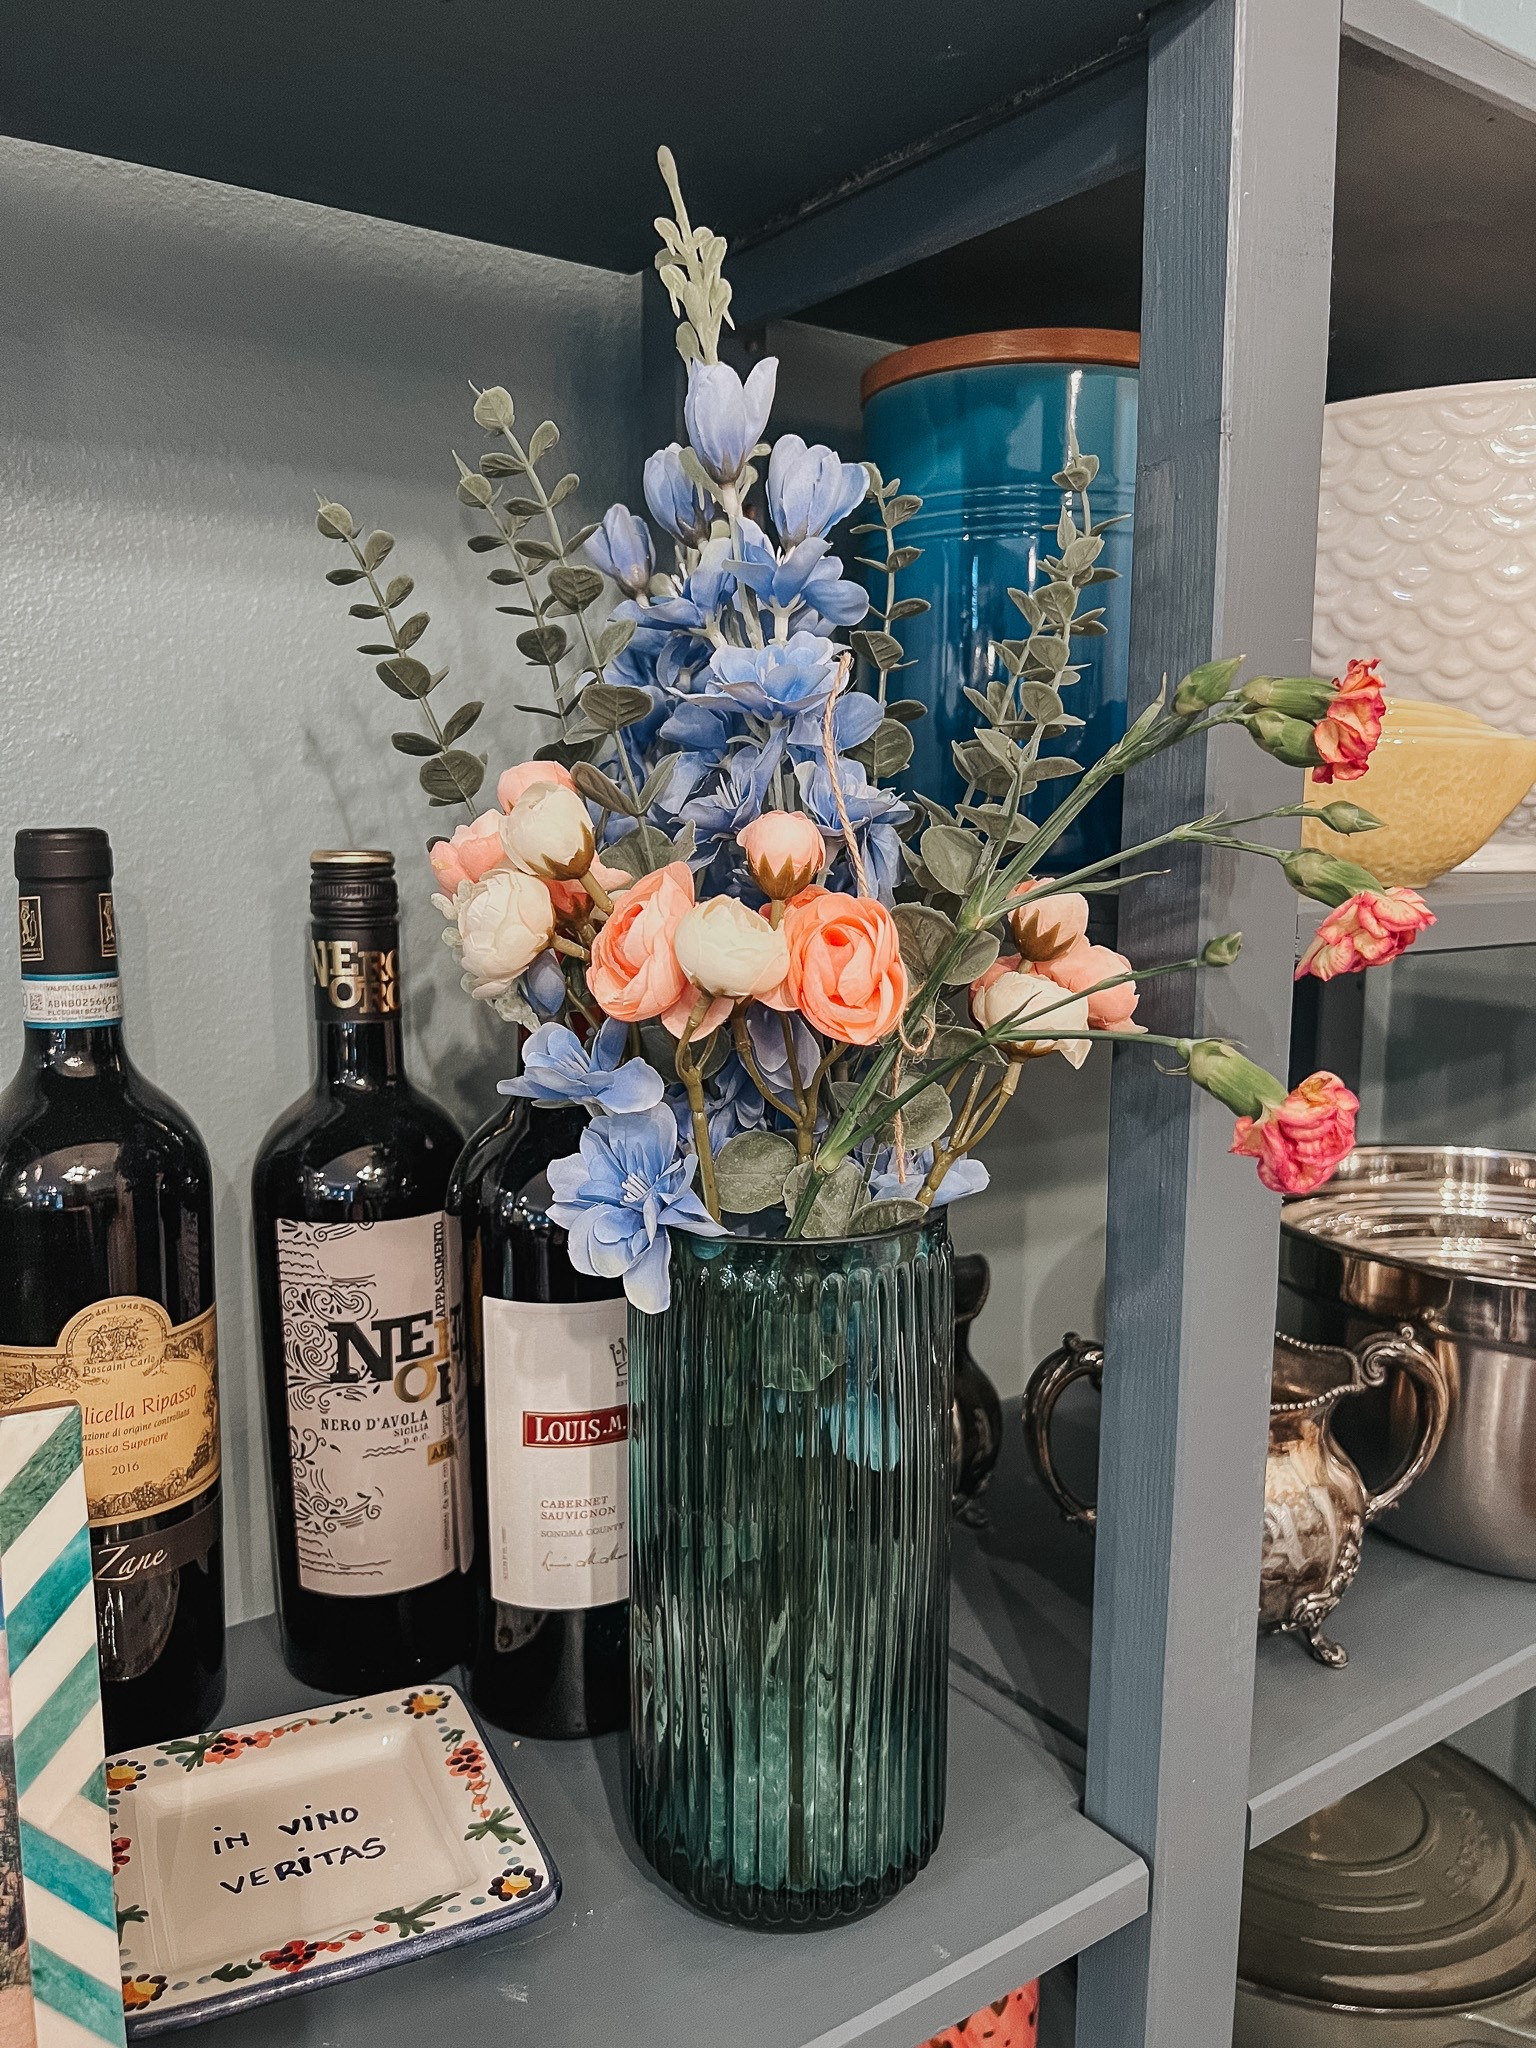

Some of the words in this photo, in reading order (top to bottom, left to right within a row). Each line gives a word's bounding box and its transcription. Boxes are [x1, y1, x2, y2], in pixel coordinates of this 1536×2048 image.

[434, 1221, 445, 1317] APPASSIMENTO
[95, 1306, 110, 1316] dal
[115, 1303, 139, 1312] 1948
[83, 1361, 126, 1375] Boscaini
[130, 1355, 156, 1368] Carlo
[85, 1402, 135, 1425] licella
[143, 1384, 197, 1415] Ripasso
[82, 1431, 110, 1442] azione
[113, 1428, 121, 1437] di
[124, 1423, 151, 1436] origine
[154, 1408, 190, 1428] controllata
[321, 1418, 361, 1431] NERO
[366, 1409, 428, 1430] D'AVOLA
[393, 1422, 429, 1437] SICILIA
[84, 1444, 119, 1457] lassico
[123, 1431, 169, 1450] Superiore
[112, 1462, 140, 1476] 2016
[541, 1496, 608, 1509] CABERNET
[541, 1506, 616, 1520] SAUVIGNON
[541, 1529, 583, 1538] SONOMA
[586, 1521, 625, 1535] COUNTY
[94, 1544, 168, 1580] Zane
